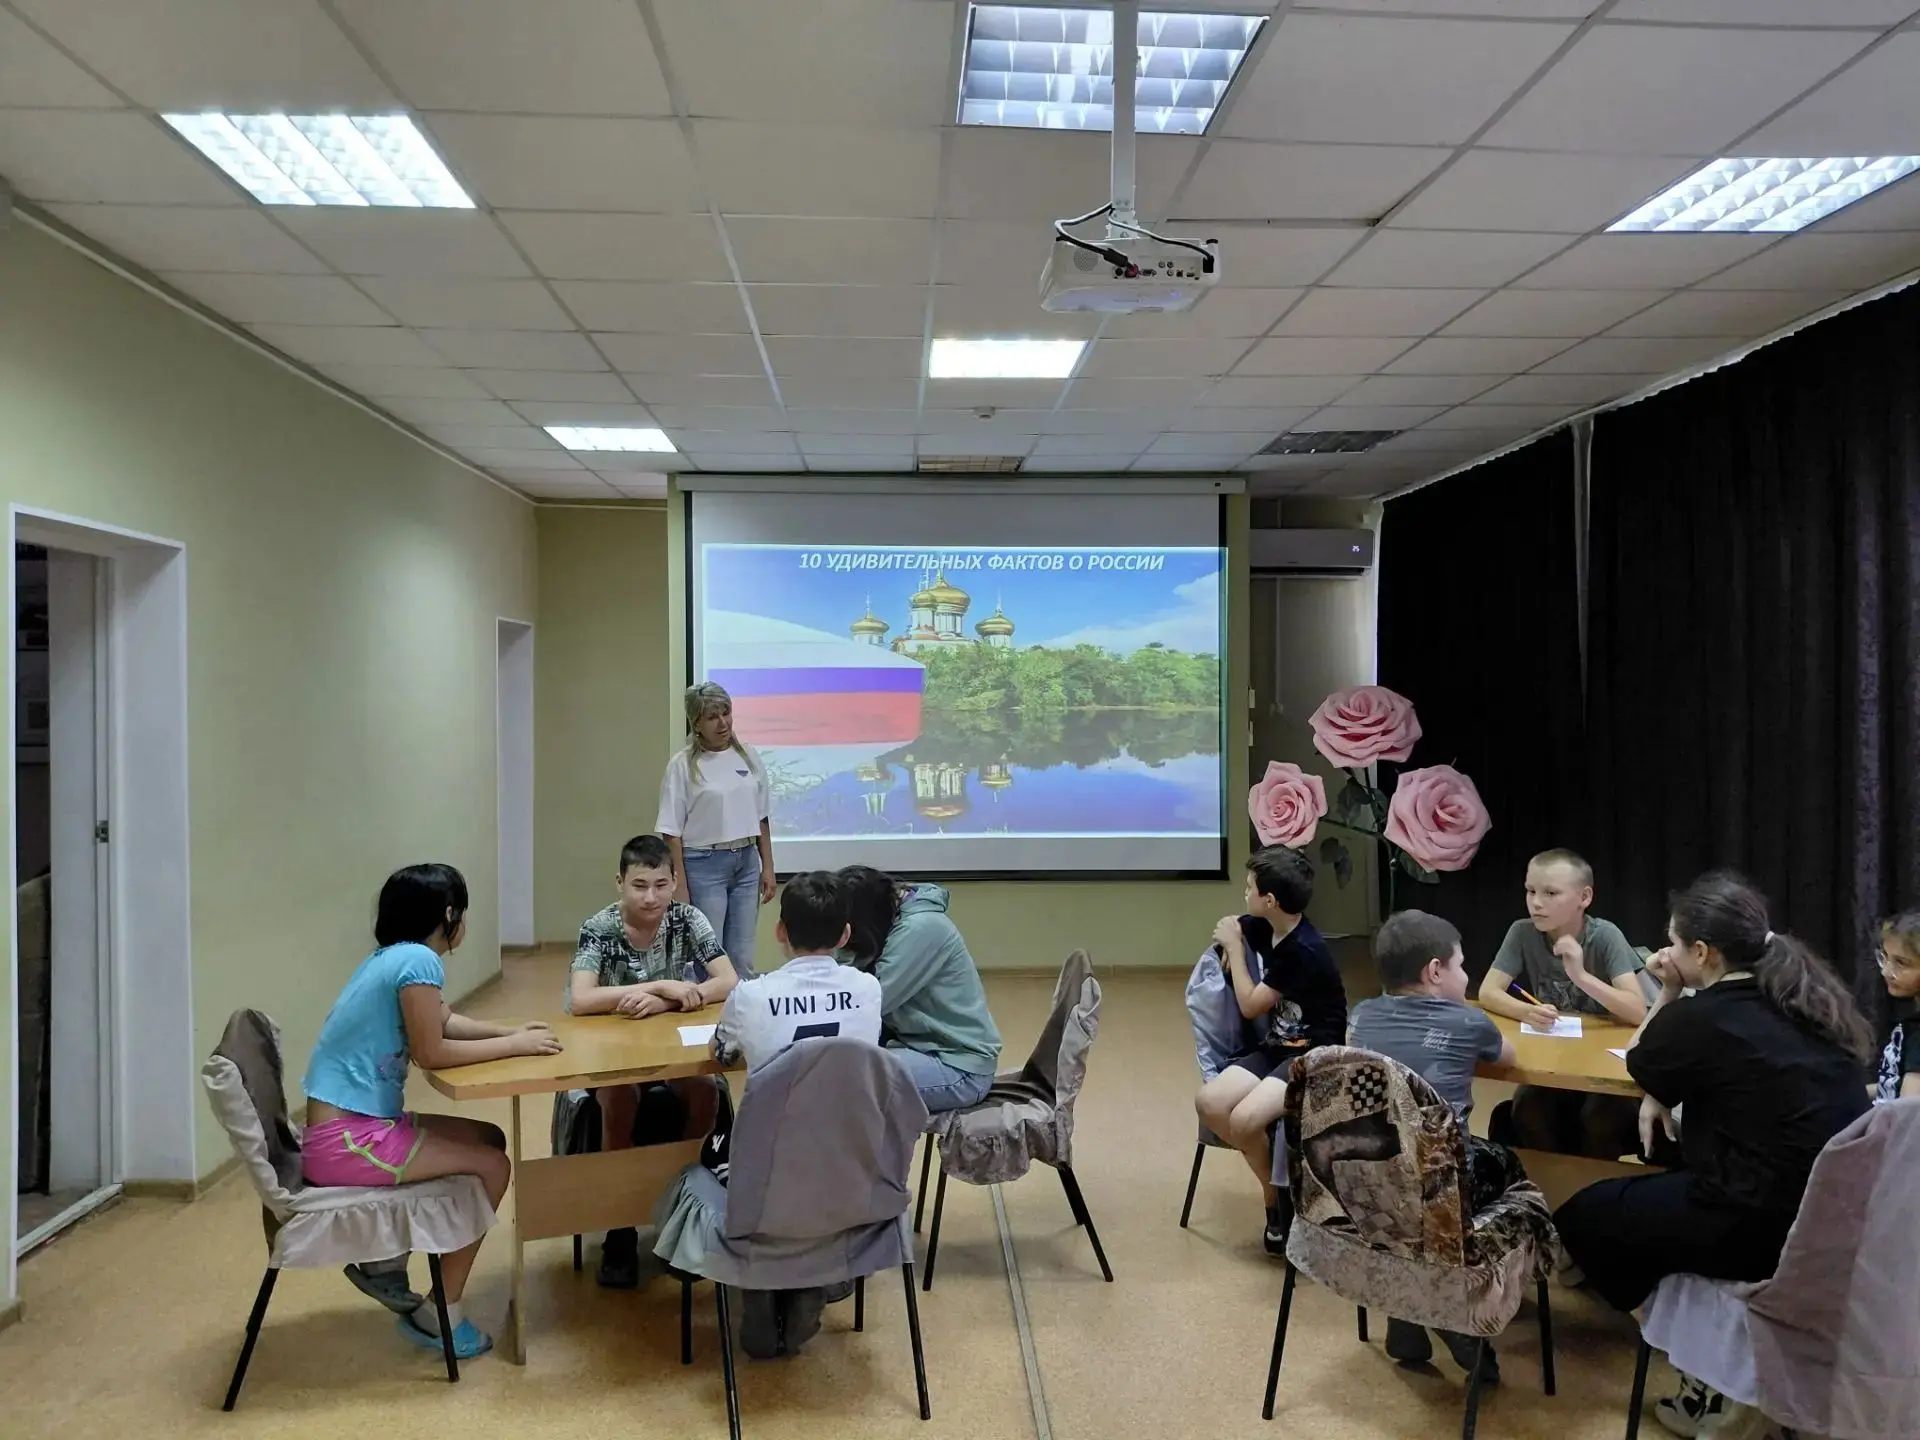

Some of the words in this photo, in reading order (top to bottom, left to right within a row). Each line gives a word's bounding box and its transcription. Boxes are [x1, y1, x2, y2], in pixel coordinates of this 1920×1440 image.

[799, 553, 821, 569] 10
[826, 554, 983, 572] УДИВИТЕЛЬНЫХ
[987, 554, 1064, 570] ФАКТОВ
[1068, 554, 1083, 570] О
[1088, 554, 1165, 570] РОССИИ
[769, 995, 816, 1016] VINI
[825, 991, 861, 1012] JR.
